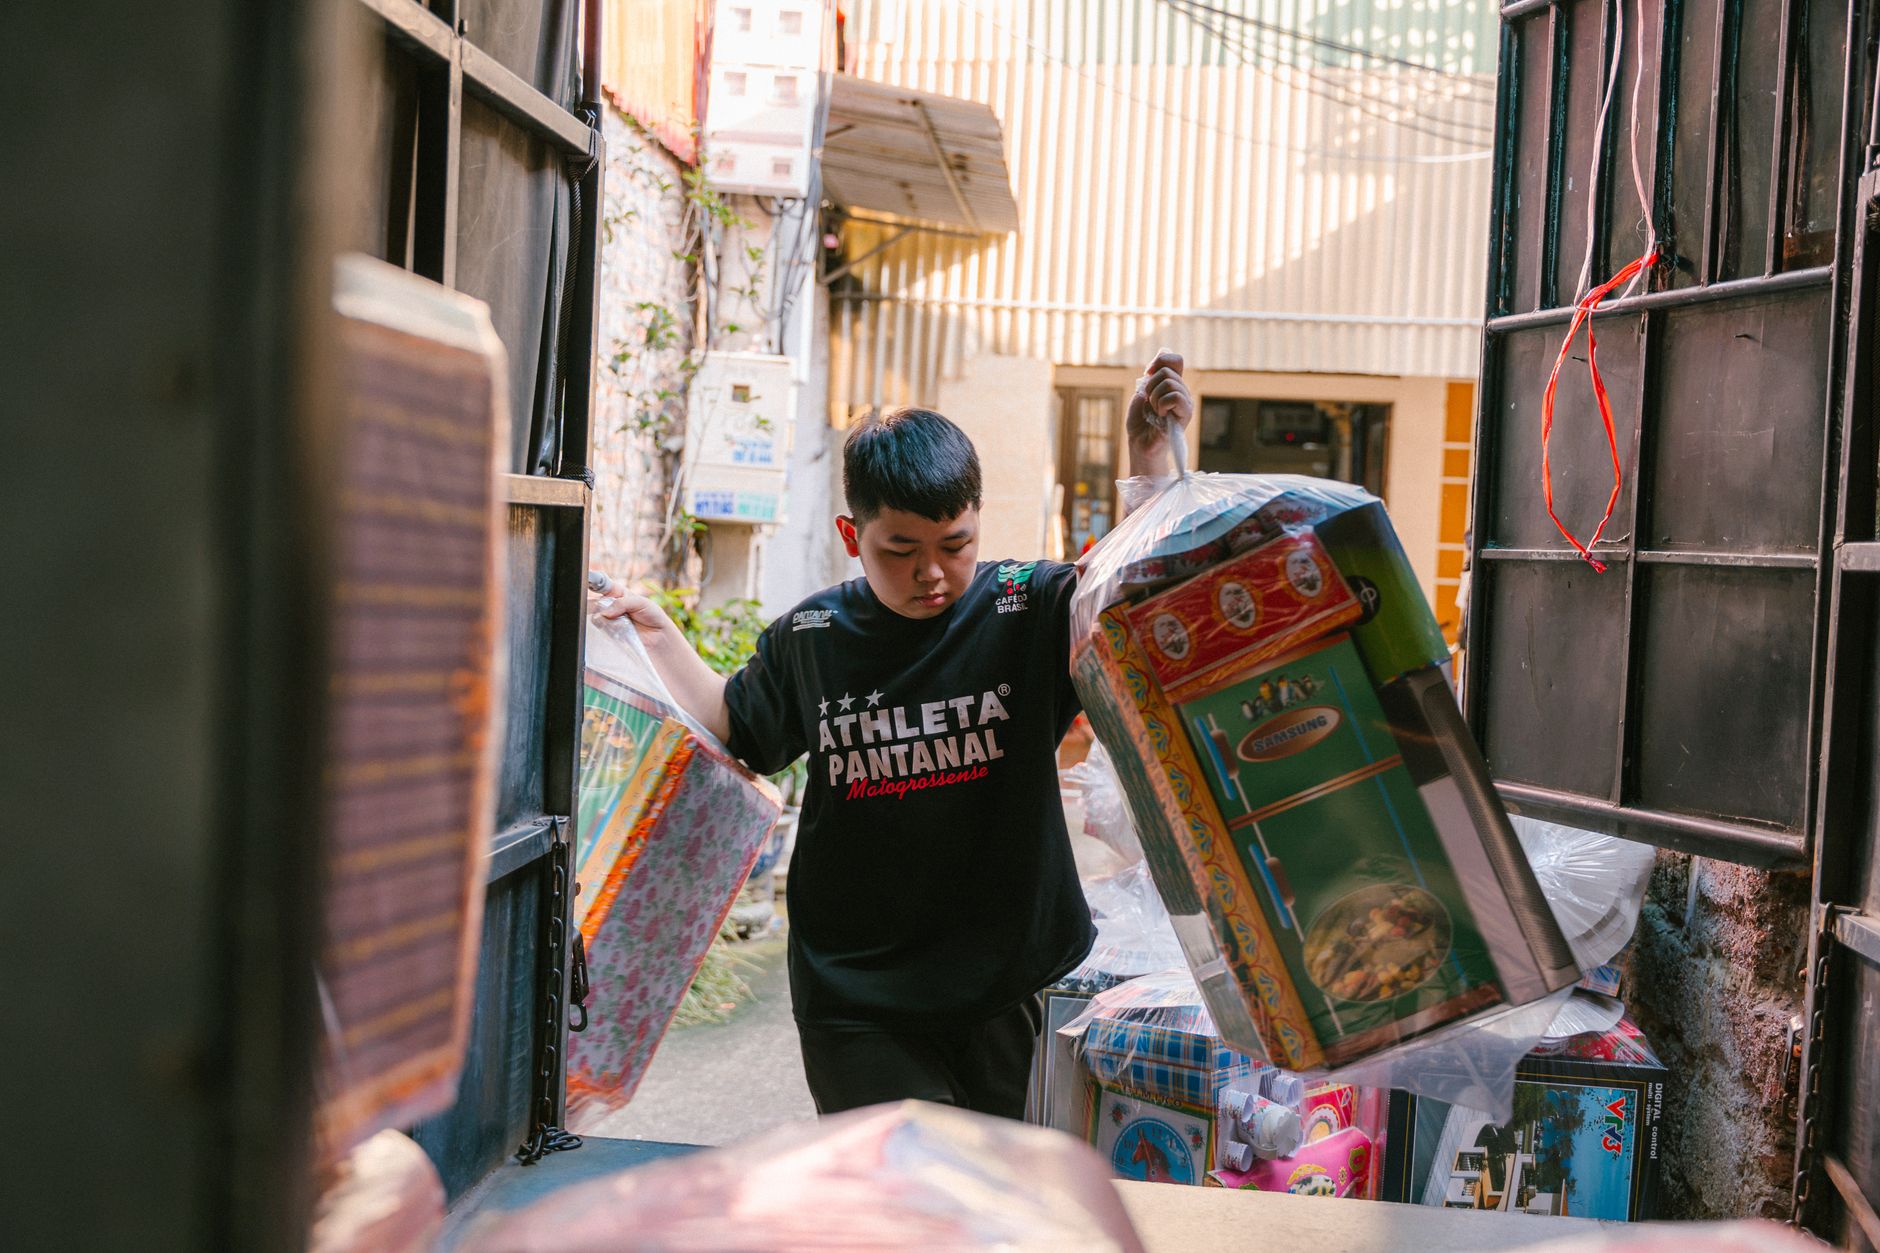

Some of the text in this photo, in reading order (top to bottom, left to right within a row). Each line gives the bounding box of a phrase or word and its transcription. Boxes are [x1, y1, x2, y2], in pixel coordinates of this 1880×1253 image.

[1254, 715, 1328, 752] SAMSUNG
[828, 729, 1004, 786] PANTANAL
[847, 765, 989, 800] Matogrossense
[1650, 1083, 1663, 1159] DIGITAL control
